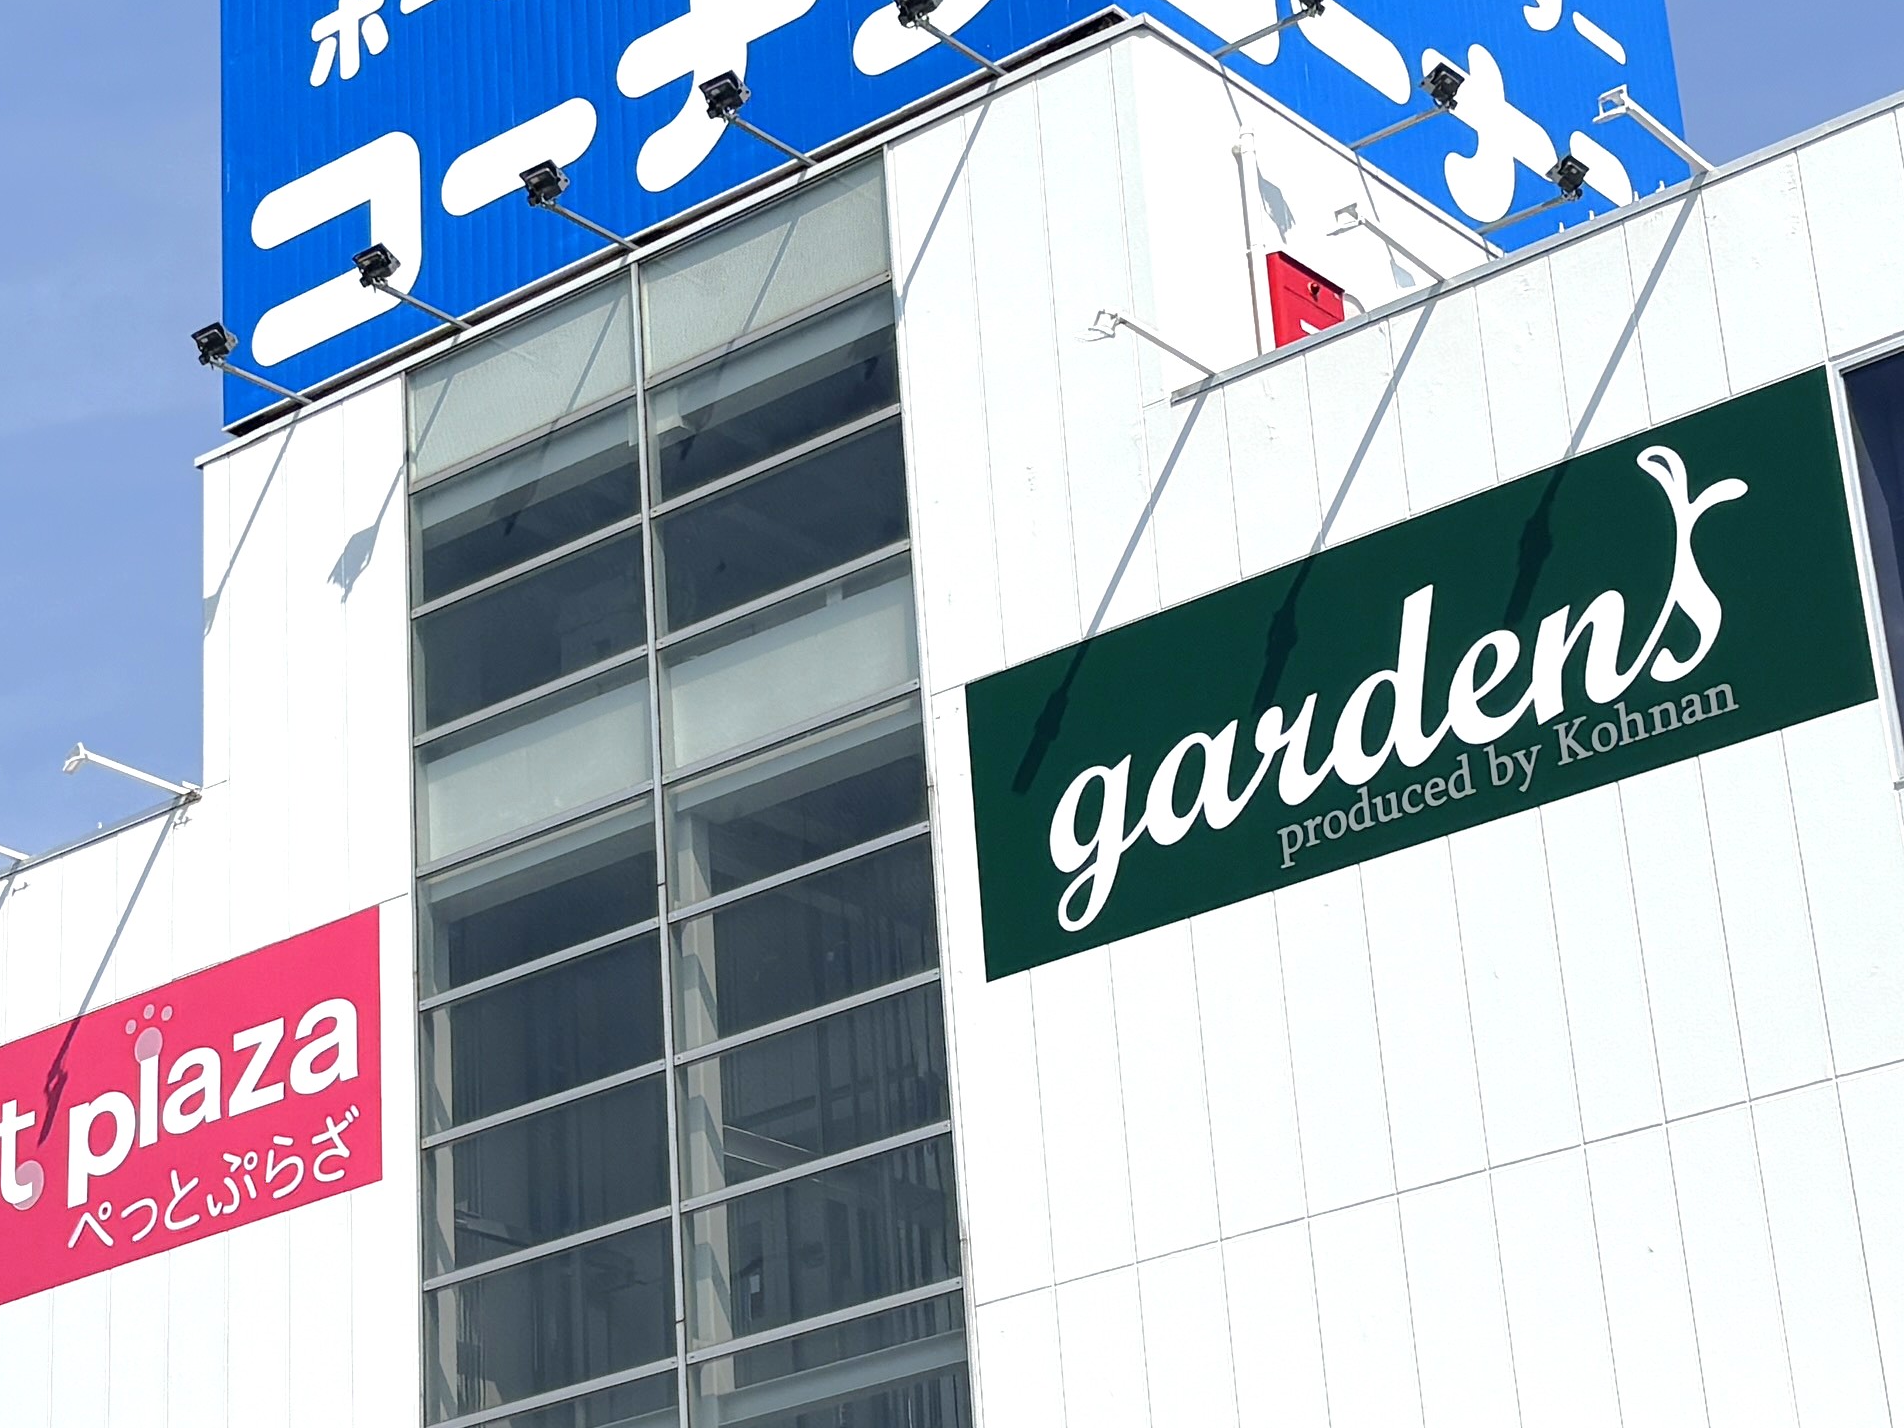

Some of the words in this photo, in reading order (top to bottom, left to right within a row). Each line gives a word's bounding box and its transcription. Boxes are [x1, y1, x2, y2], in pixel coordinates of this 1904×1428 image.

[1049, 444, 1749, 933] gardens
[1278, 755, 1474, 868] produced
[1486, 744, 1542, 793] by
[1556, 680, 1739, 768] Kohnan
[66, 997, 359, 1209] plaza
[67, 1105, 360, 1249] ぺっとぷらざ
